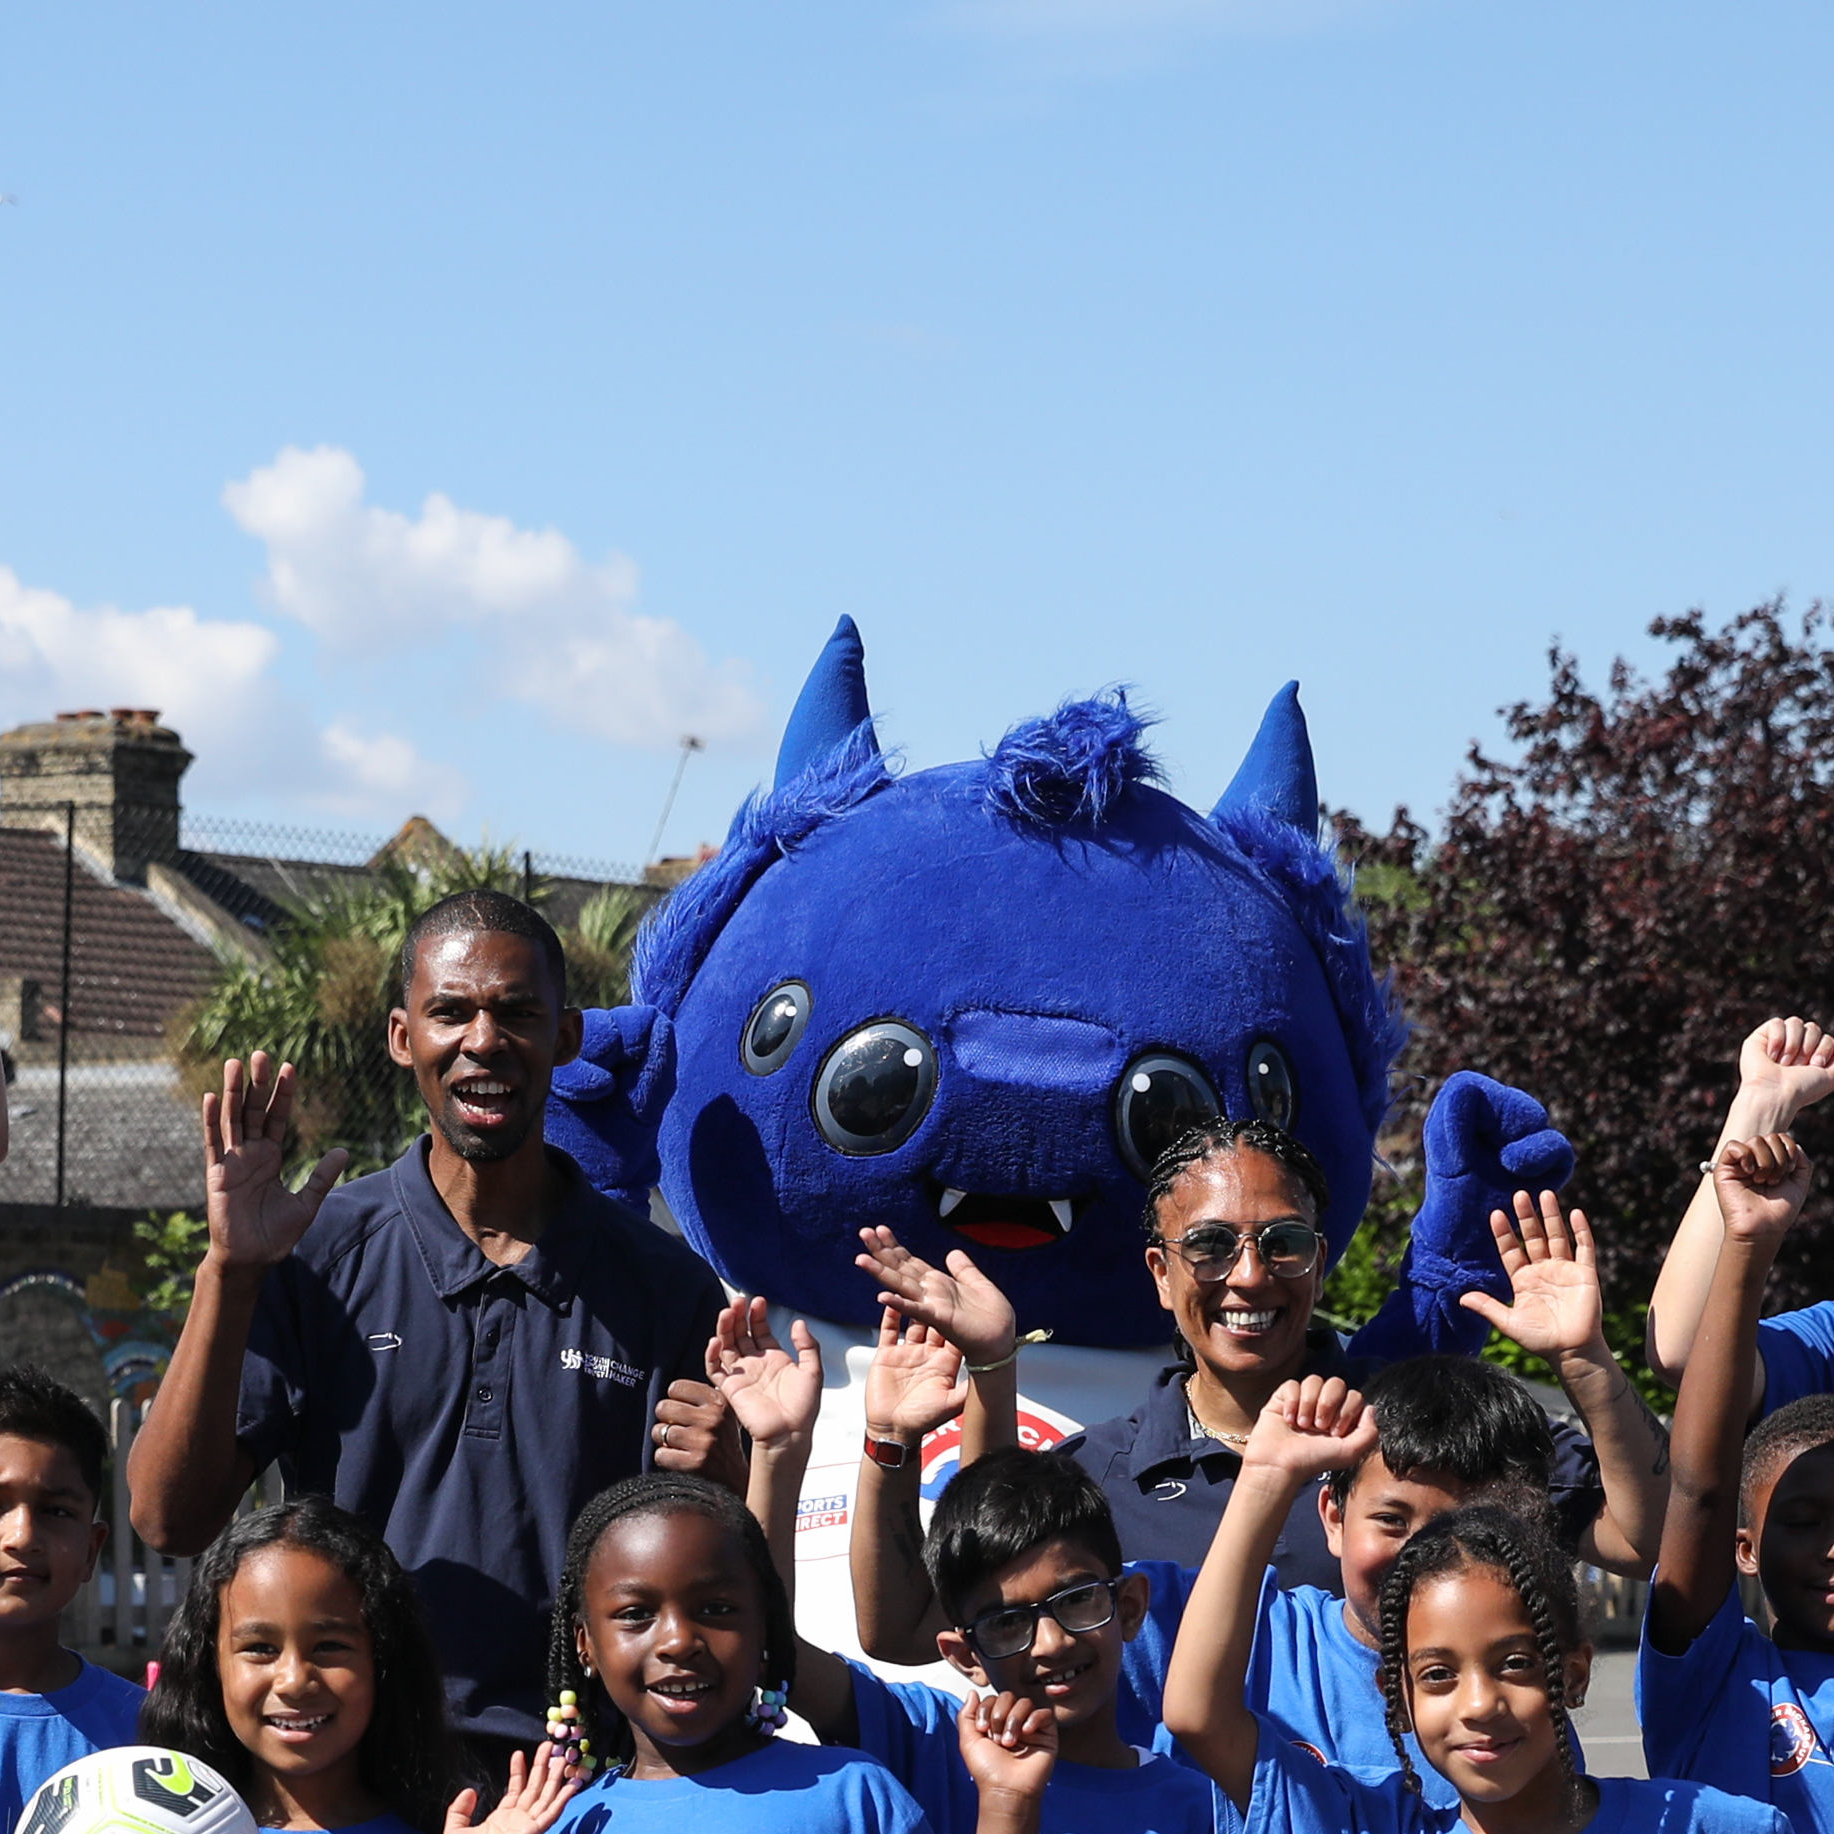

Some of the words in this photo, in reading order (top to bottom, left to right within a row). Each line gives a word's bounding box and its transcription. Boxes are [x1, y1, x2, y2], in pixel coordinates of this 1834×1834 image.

[609, 1370, 636, 1387] MAKER
[610, 1361, 645, 1379] CHANGE
[798, 1496, 845, 1512] PORTS
[796, 1512, 844, 1531] IRECT
